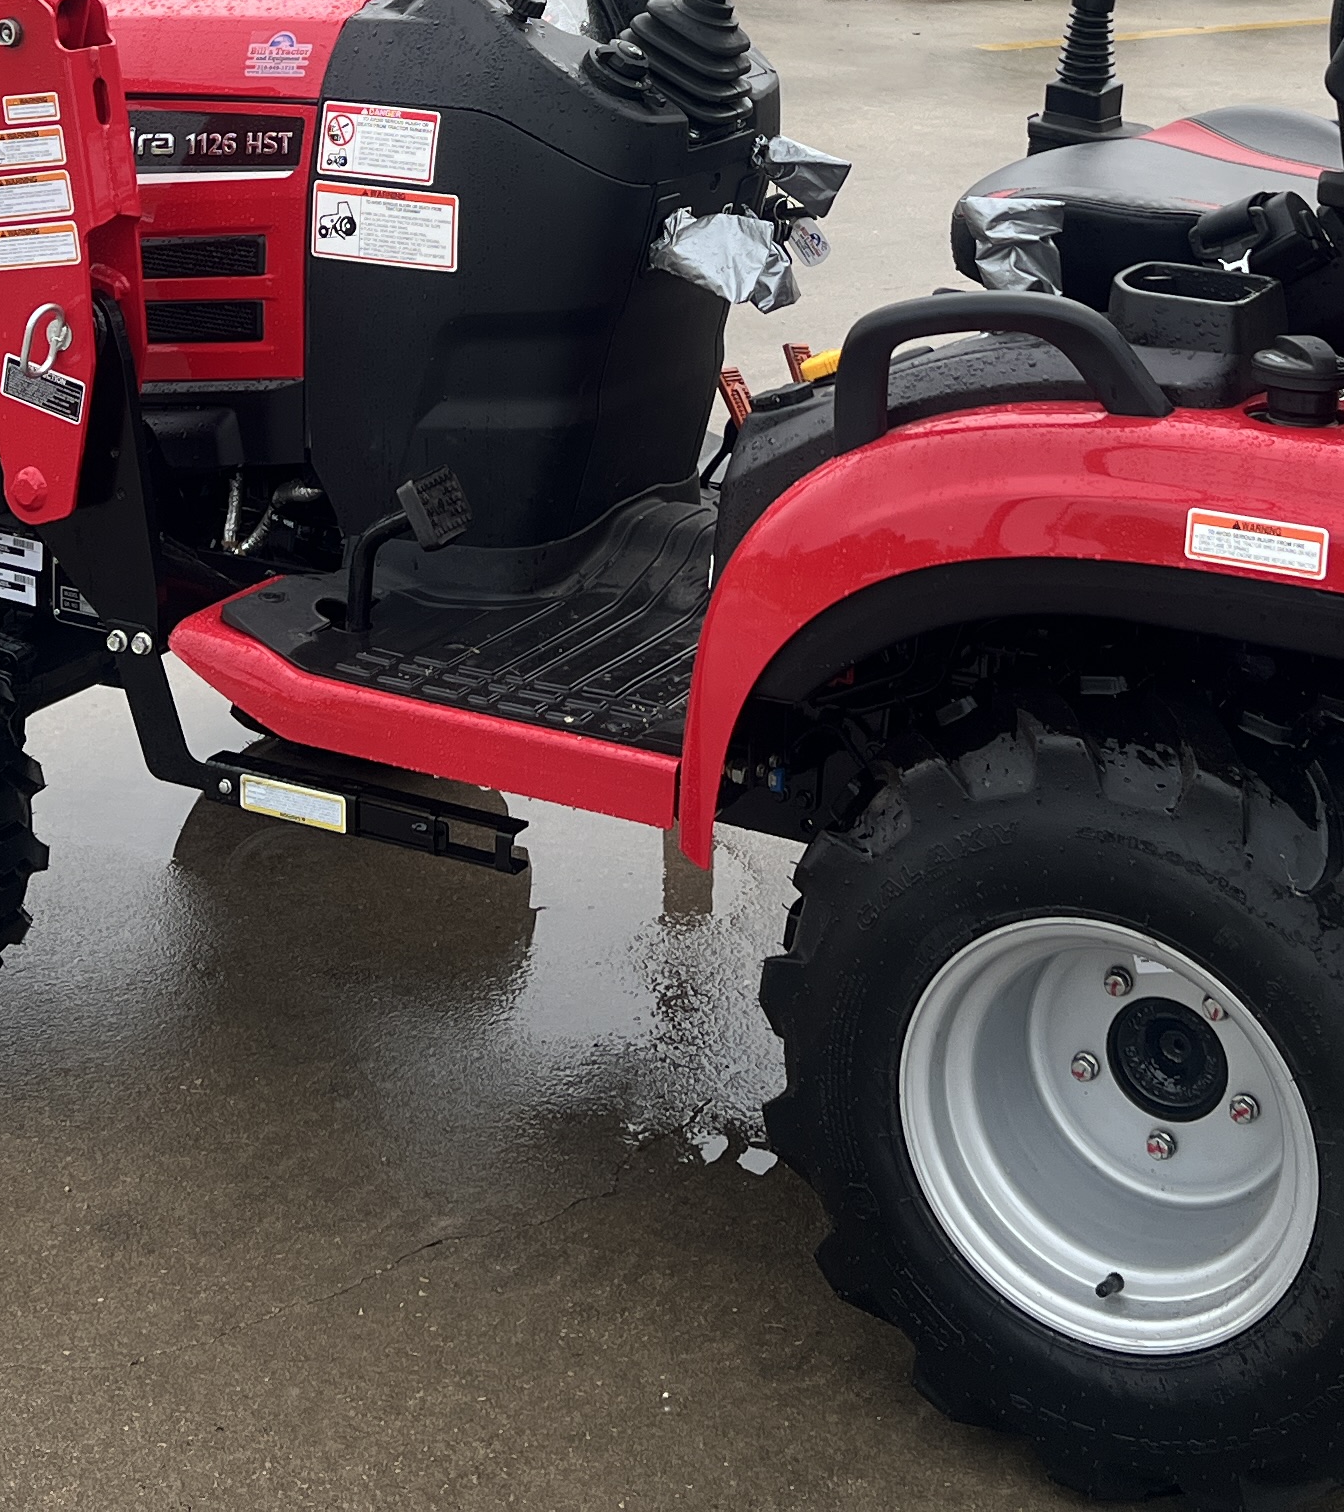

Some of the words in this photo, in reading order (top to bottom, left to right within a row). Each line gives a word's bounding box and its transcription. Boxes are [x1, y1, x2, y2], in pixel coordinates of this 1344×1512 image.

[276, 47, 309, 55] Tractor
[369, 107, 402, 118] DANGER
[185, 132, 237, 156] 1126
[245, 131, 293, 155] HST
[371, 189, 406, 200] WARNING
[1242, 521, 1282, 536] WARNING
